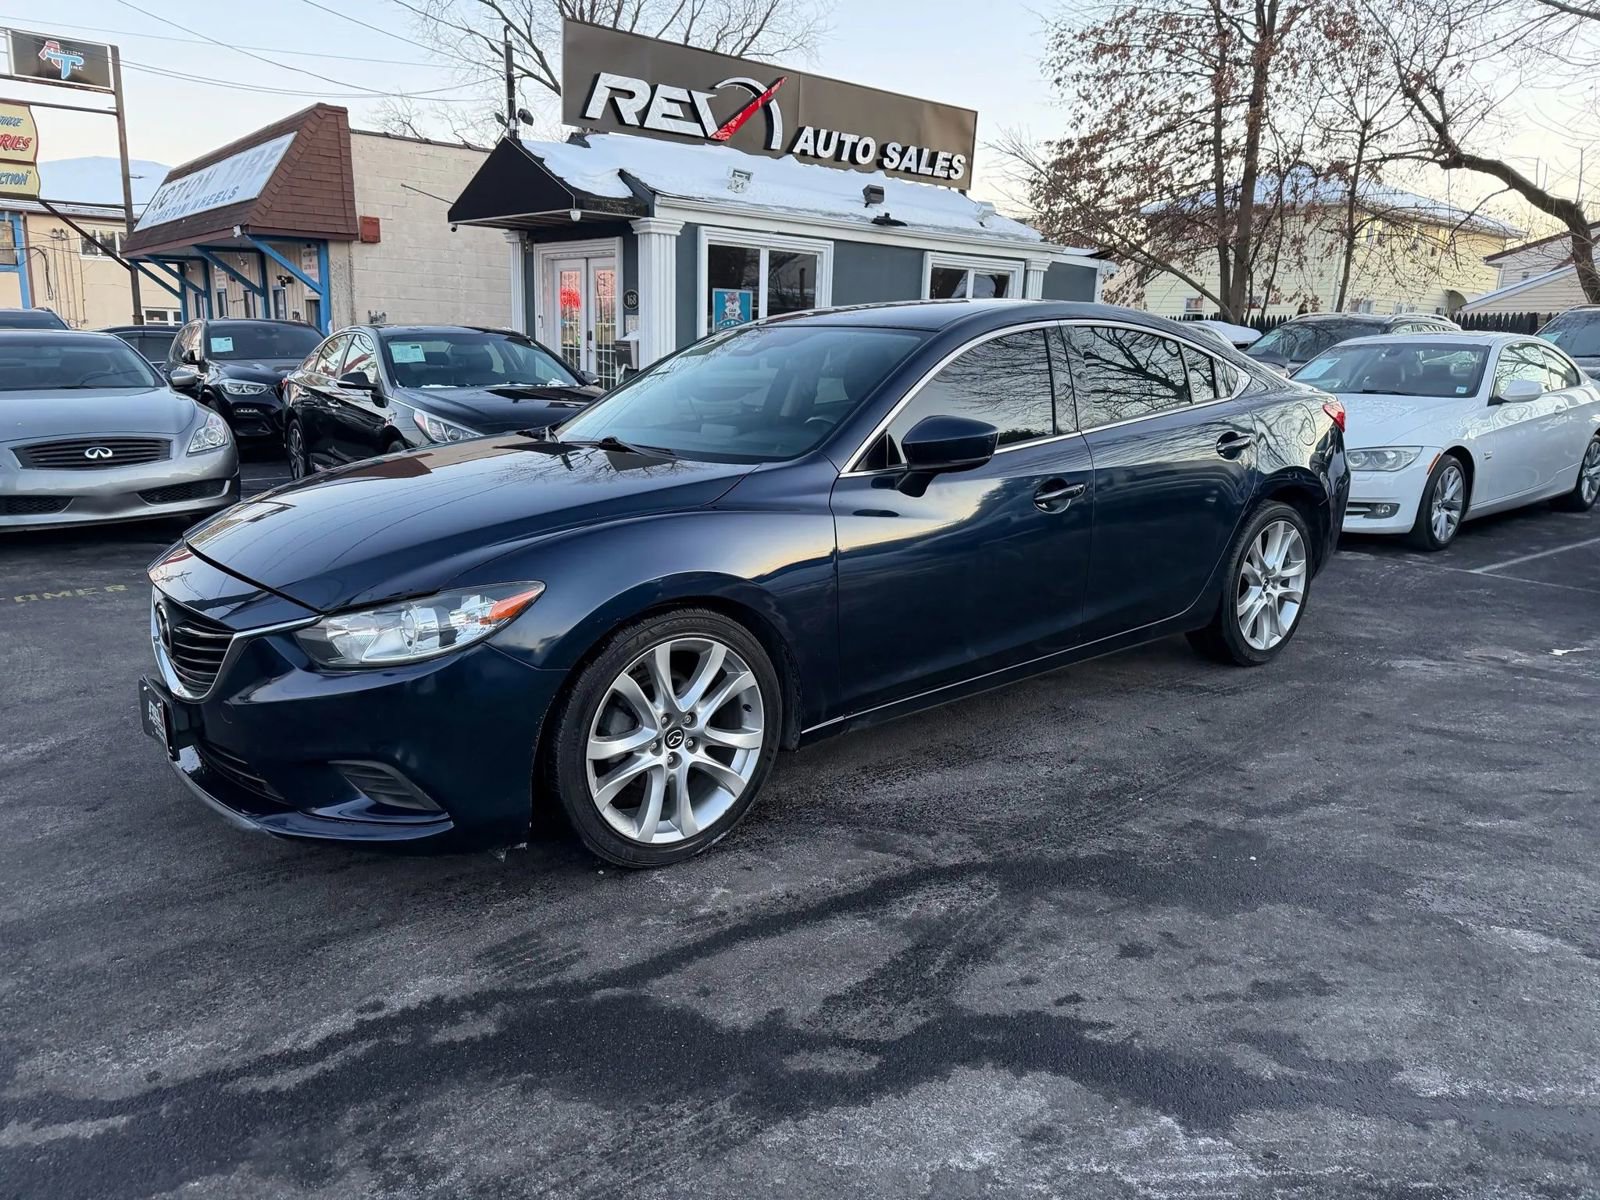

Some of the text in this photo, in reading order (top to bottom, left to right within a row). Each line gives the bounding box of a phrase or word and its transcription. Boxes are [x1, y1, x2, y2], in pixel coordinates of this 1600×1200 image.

[0, 133, 32, 151] RIES
[793, 126, 967, 181] AUTO SALES
[149, 170, 217, 213] ACTION
[190, 186, 240, 211] WHEELS
[0, 584, 129, 603] OMER
